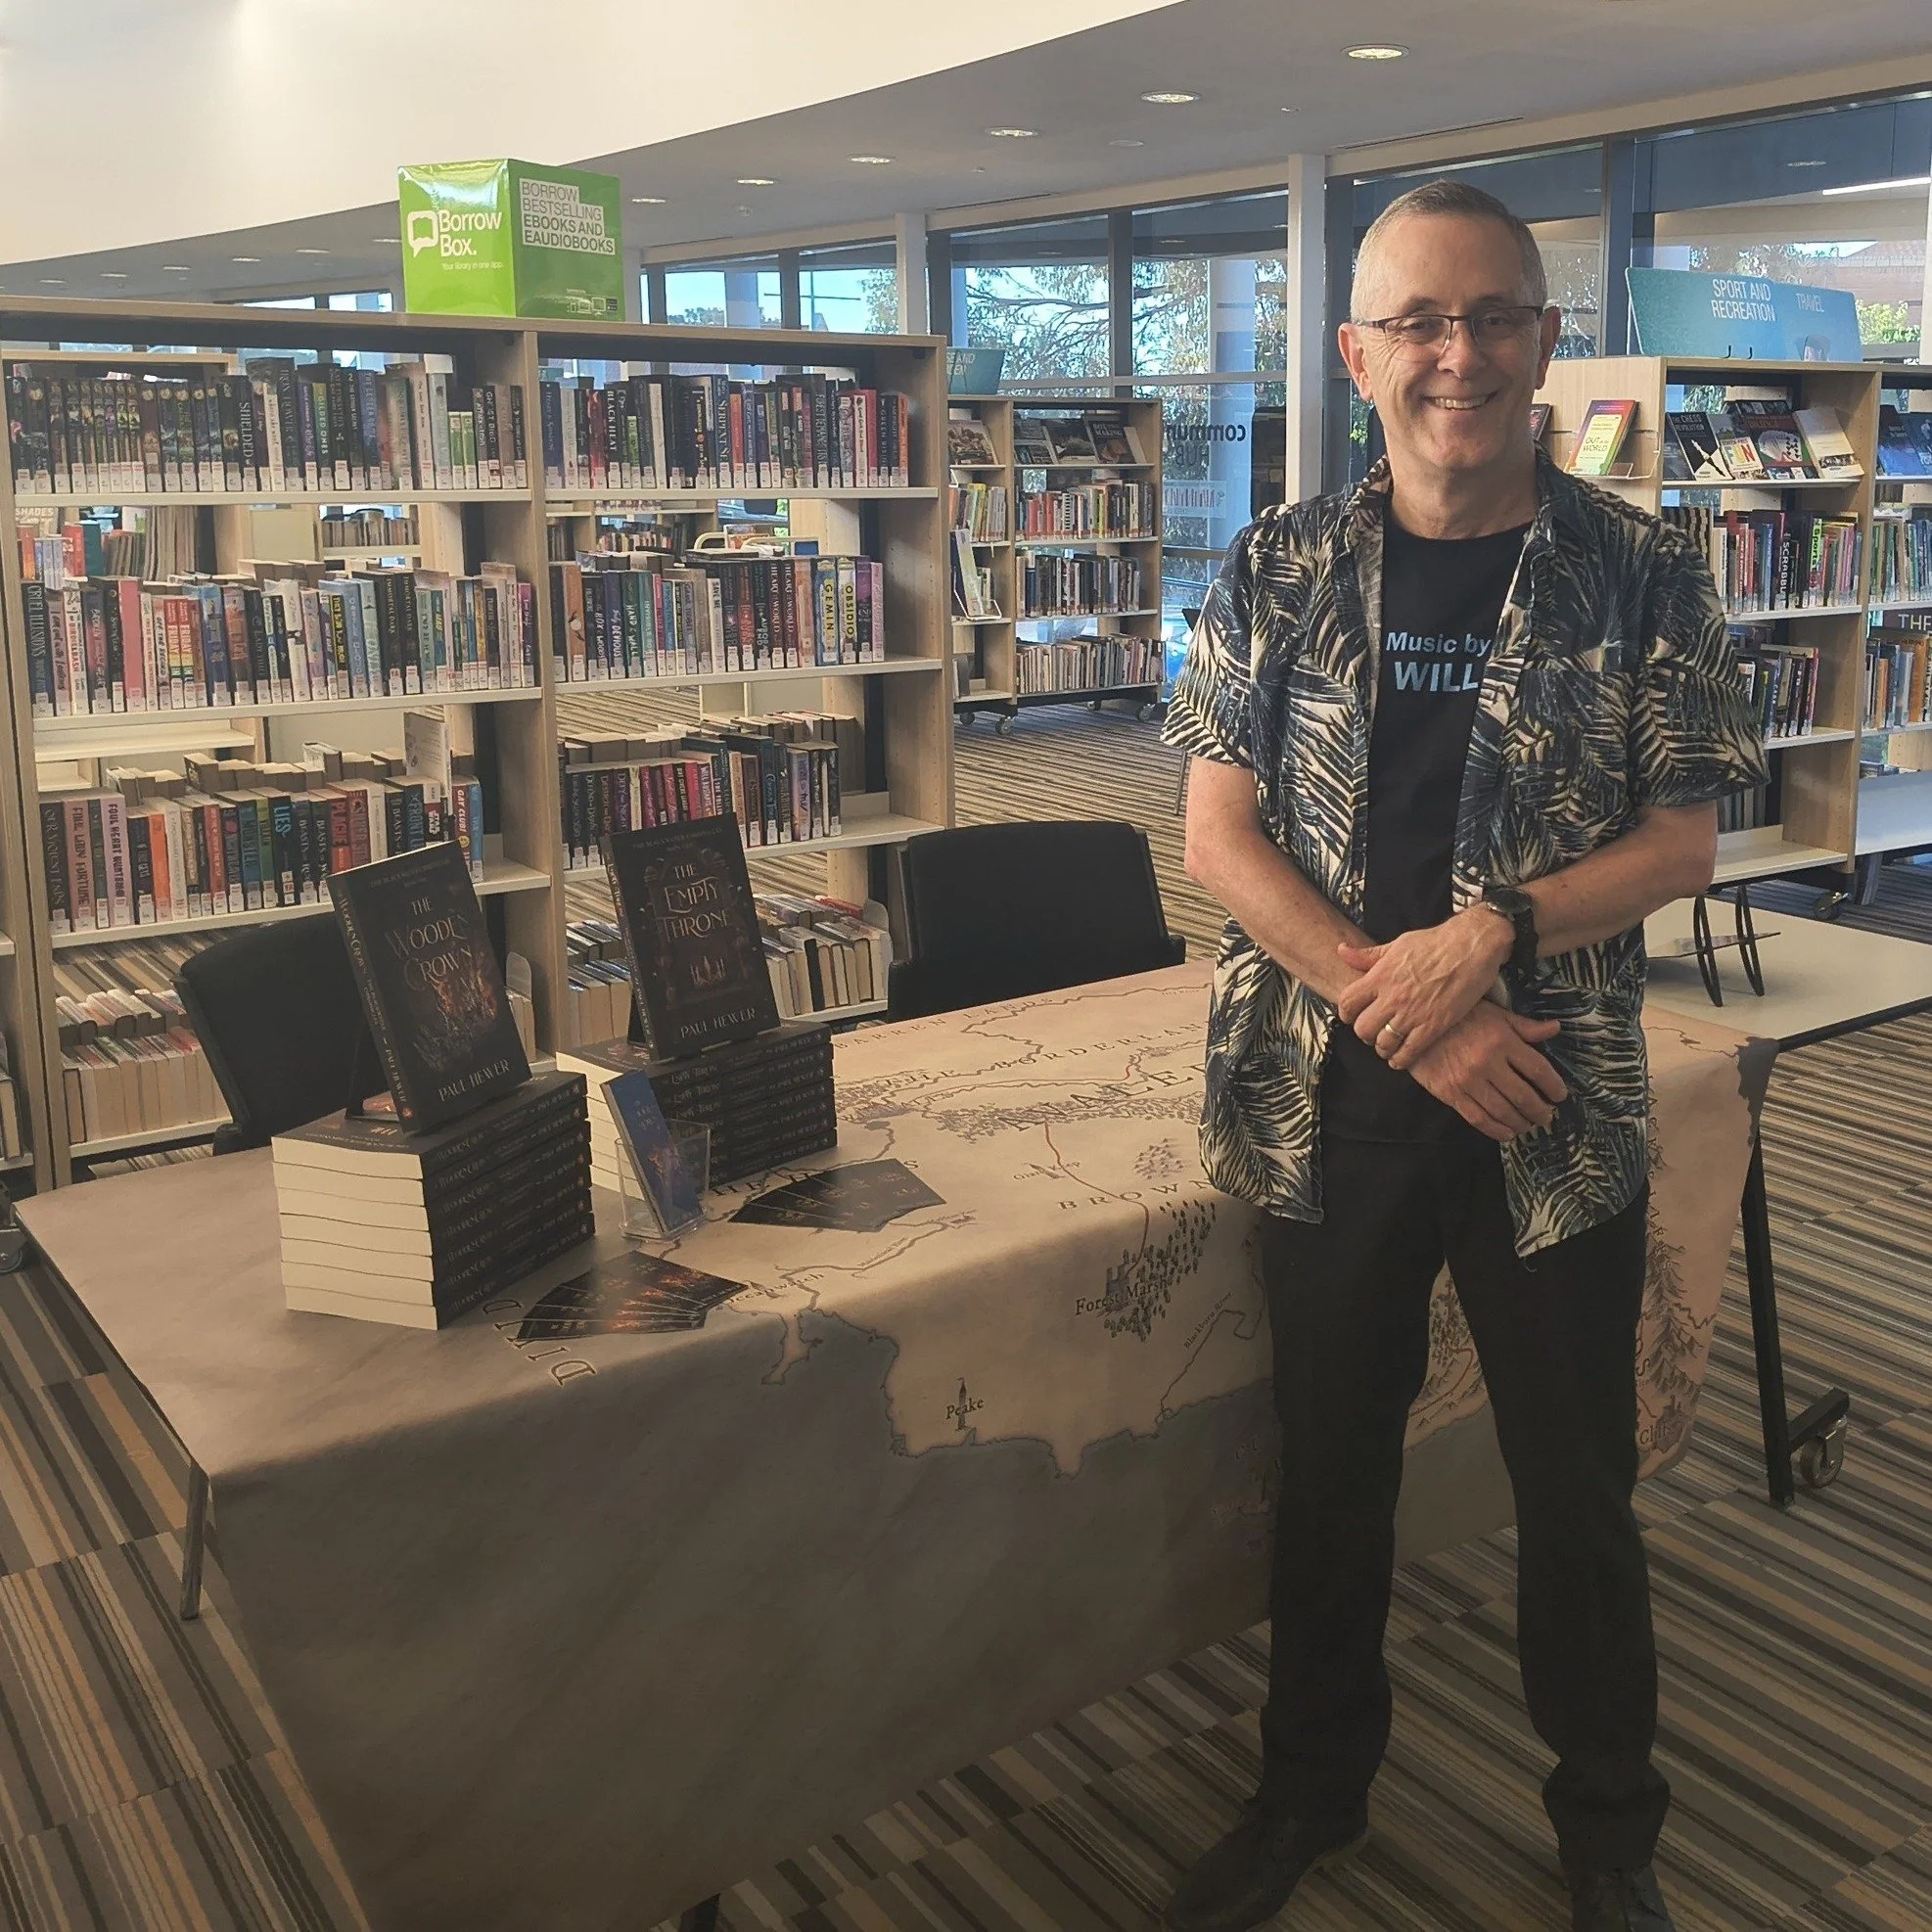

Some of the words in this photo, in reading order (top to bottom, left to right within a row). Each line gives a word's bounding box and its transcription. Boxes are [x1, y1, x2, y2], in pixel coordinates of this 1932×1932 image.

[522, 181, 577, 202] BORROW
[439, 209, 502, 233] Borrow
[523, 199, 602, 221] BESTSELLING
[524, 213, 576, 235] EBOOKS
[578, 220, 603, 236] AND
[439, 234, 478, 257] Box.
[525, 230, 614, 253] EAUDIOBOOKS
[1712, 279, 1747, 299] SPORT
[1750, 282, 1771, 301] AND
[1795, 293, 1824, 313] TRAVEL
[1711, 299, 1776, 322] RECREATION
[239, 401, 254, 458] SHIELDED
[1725, 444, 1756, 466] FUN
[15, 507, 54, 517] SHADES
[27, 585, 44, 611] CRUEL
[714, 599, 720, 609] ME
[825, 583, 834, 636] GEMIN
[845, 584, 854, 636] OBSIDIO
[626, 604, 637, 624] HAND
[168, 624, 179, 653] FRIDAY
[180, 624, 191, 654] FRIDAY
[612, 624, 621, 658] DEVIOUS
[628, 634, 639, 657] WALL
[1386, 631, 1457, 653] Music
[1464, 633, 1492, 657] by
[1394, 661, 1479, 692] WILL
[72, 806, 84, 831] FOUL
[108, 804, 118, 825] FOUL
[273, 805, 292, 834] LIES
[458, 807, 467, 833] CLUB!
[74, 834, 87, 858] LADY
[111, 826, 122, 853] HEART
[316, 820, 327, 853] BEASTS
[75, 862, 90, 906] FORTUNE
[673, 863, 698, 880] THE
[410, 897, 432, 916] THE
[664, 876, 721, 914] EMPTY
[384, 913, 470, 959] WOODEN
[655, 908, 729, 943] THRONE
[403, 945, 474, 991] CROWN
[679, 1024, 709, 1038] PAUL
[713, 1006, 757, 1035] HEWER
[834, 1018, 947, 1050] BARREN
[994, 1020, 1210, 1069] BORDERLAN
[437, 1081, 467, 1103] PAUL
[468, 1058, 511, 1093] HEWER
[1075, 1291, 1120, 1317] Forest
[944, 1396, 985, 1420] Peake
